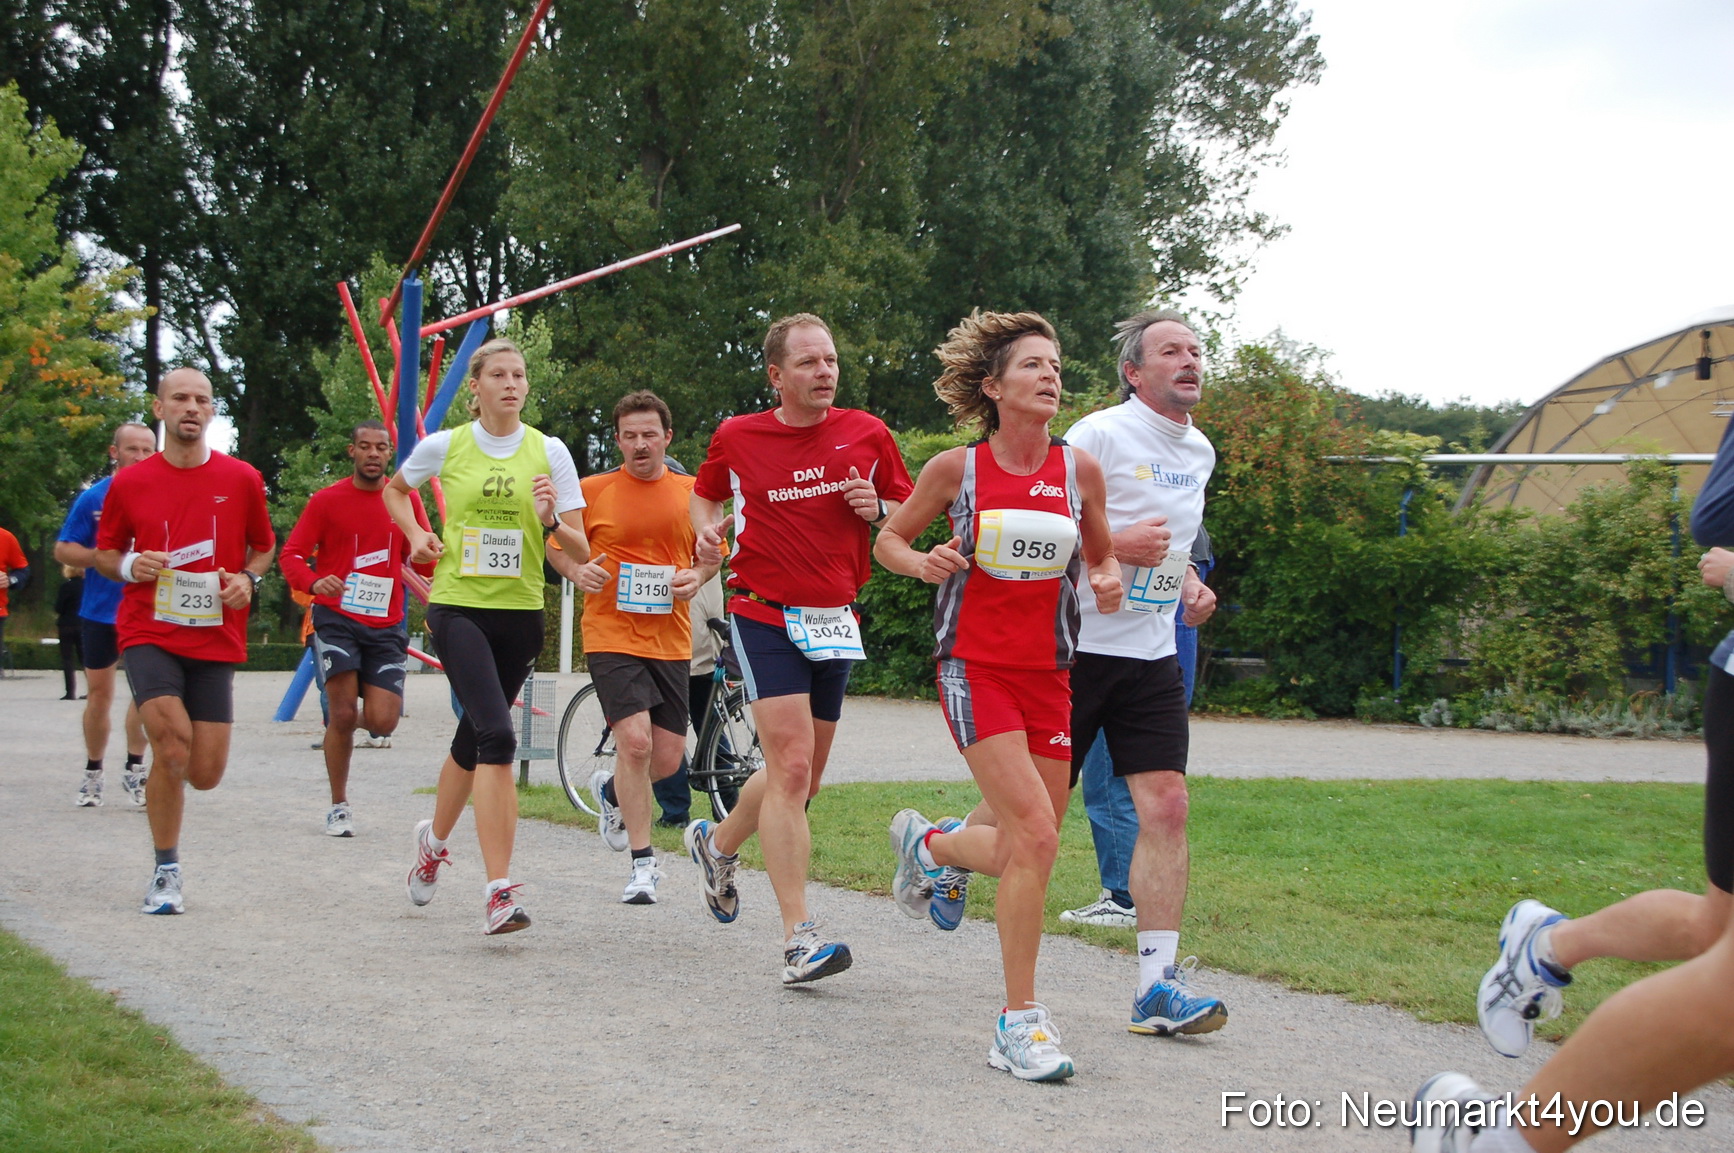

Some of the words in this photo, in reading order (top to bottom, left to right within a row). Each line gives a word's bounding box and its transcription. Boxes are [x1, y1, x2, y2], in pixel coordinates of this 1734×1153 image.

[793, 466, 825, 482] DAV
[482, 533, 516, 547] Claudia
[464, 549, 470, 558] B
[1011, 538, 1057, 560] 958
[488, 552, 520, 569] 331
[634, 568, 665, 579] Gerhard
[175, 576, 207, 589] Helmut
[358, 589, 386, 603] 2377
[634, 583, 669, 597] 3150
[180, 593, 213, 609] 233
[804, 613, 842, 625] Wolfgang
[810, 624, 853, 639] 3042
